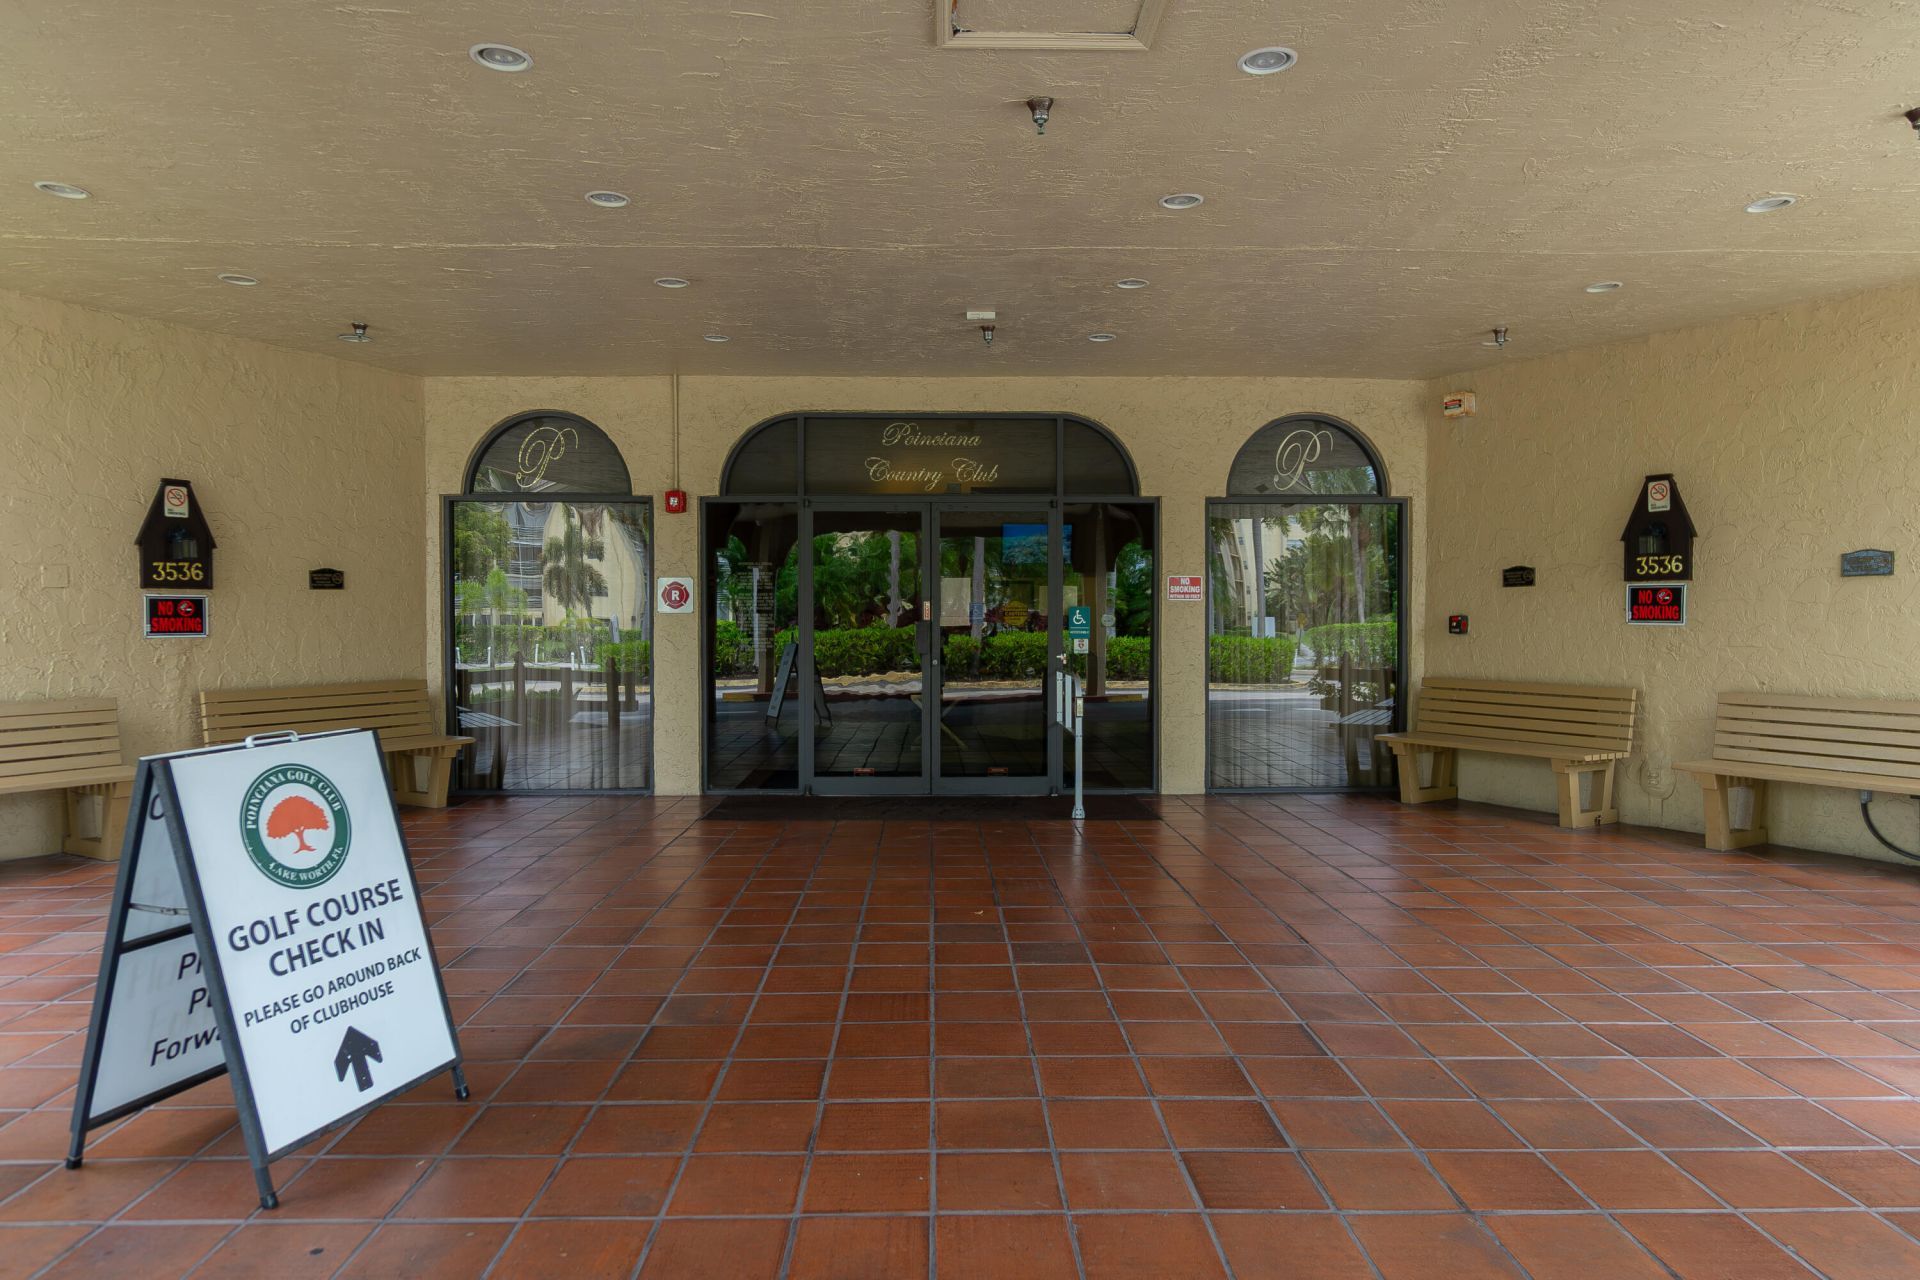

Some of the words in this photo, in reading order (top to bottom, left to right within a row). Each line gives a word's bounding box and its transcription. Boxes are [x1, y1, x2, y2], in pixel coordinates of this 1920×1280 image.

[882, 422, 981, 447] Poinciana
[516, 426, 579, 488] P
[1273, 429, 1334, 491] P
[864, 456, 944, 492] Country
[951, 457, 999, 482] Club
[152, 562, 204, 581] 3536
[1636, 555, 1683, 575] 3536
[1170, 585, 1201, 593] SMOKING
[1180, 577, 1190, 585] NO
[671, 590, 680, 601] R
[1638, 590, 1653, 605] NO
[157, 600, 174, 616] NO
[1633, 605, 1680, 619] SMOKING
[151, 617, 203, 632] SMOKING
[246, 773, 285, 829] POINCIANA
[287, 770, 318, 785] GOLF
[318, 782, 342, 811] CLUB
[268, 862, 298, 881] LAKE
[228, 909, 300, 952] GOLF
[306, 878, 403, 927] COURSE
[269, 927, 356, 976] CHECK
[358, 918, 385, 946] IN
[243, 994, 300, 1028] PLEASE
[302, 985, 324, 1003] GO
[328, 961, 385, 995] AROUND
[386, 947, 422, 971] BACK
[290, 1015, 311, 1034] OF
[313, 980, 395, 1025] CLUBHOUSE
